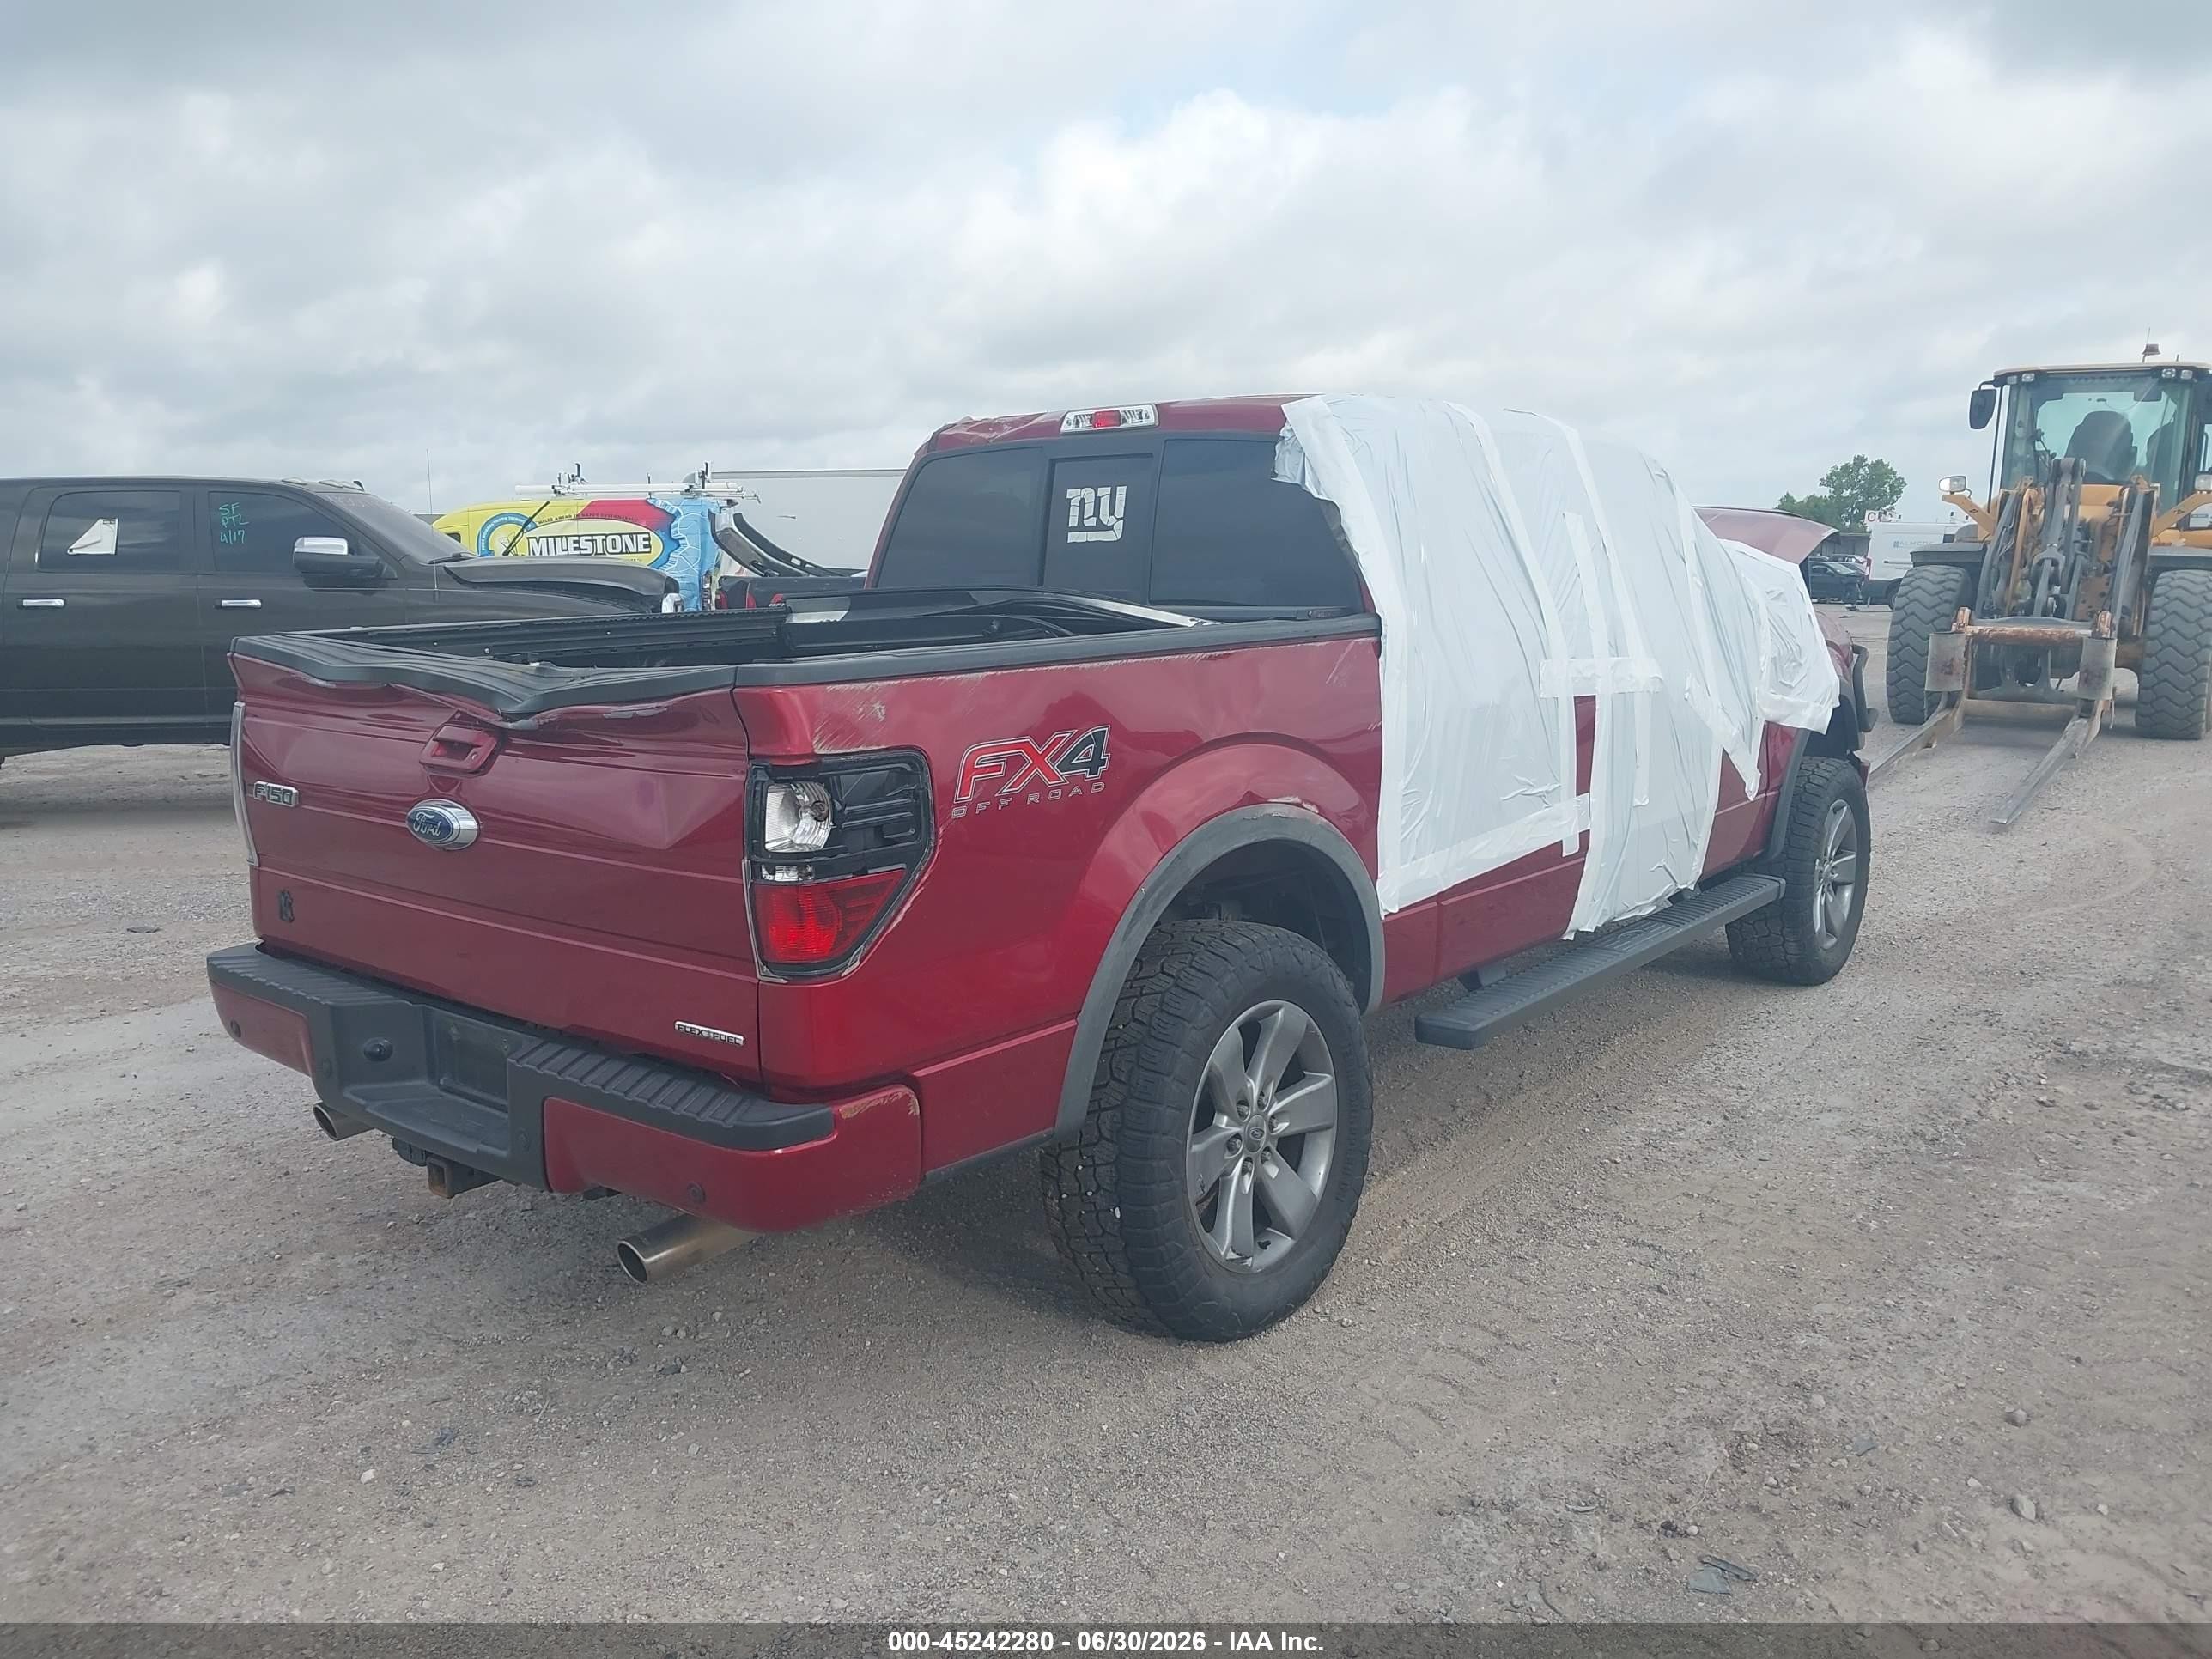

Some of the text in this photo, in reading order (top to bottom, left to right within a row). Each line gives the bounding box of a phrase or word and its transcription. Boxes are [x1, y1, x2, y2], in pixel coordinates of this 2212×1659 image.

[219, 502, 240, 516] SF
[220, 529, 245, 544] 4/17
[527, 532, 652, 556] MILESTONE
[954, 725, 1111, 804] FX4
[951, 781, 1106, 819] OFF ROAD
[413, 811, 443, 836] Ford
[678, 1024, 742, 1045] FLEX FUEL
